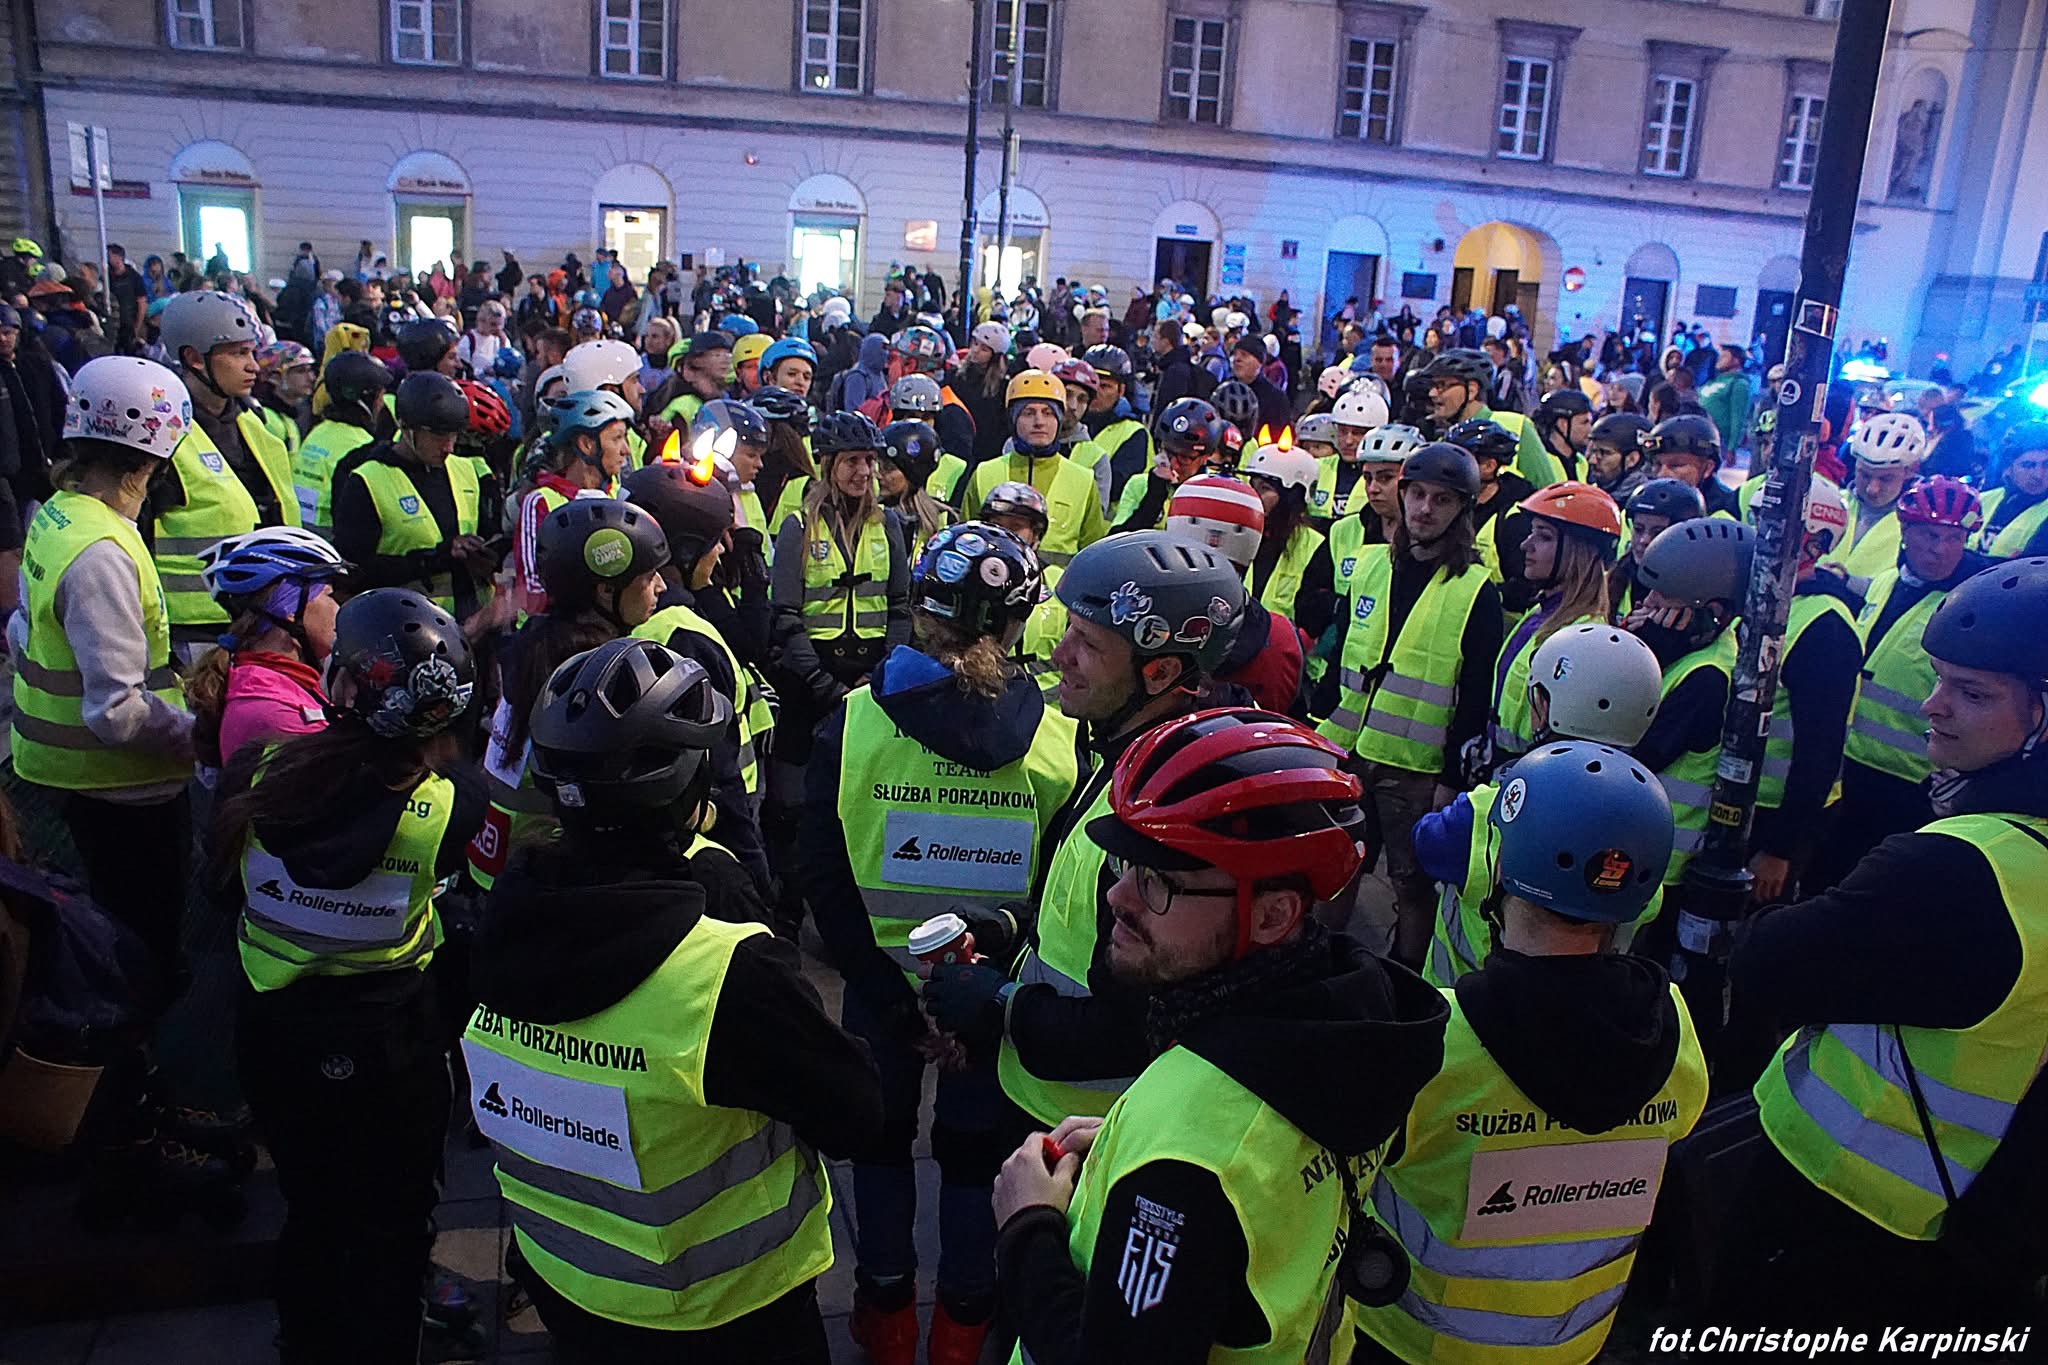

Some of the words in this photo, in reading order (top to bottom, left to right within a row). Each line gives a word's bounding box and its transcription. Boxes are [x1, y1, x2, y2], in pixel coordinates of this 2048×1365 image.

[933, 761, 992, 778] TEAM
[872, 782, 932, 803] SŁUŻBA
[926, 843, 1022, 866] Rollerblade
[288, 888, 397, 918] Rollerblade
[510, 1022, 648, 1072] PORZĄDKOWA
[511, 1096, 622, 1151] Rollerblade
[1456, 1108, 1536, 1138] SŁUŻBA
[1522, 1177, 1647, 1208] Rollerblade
